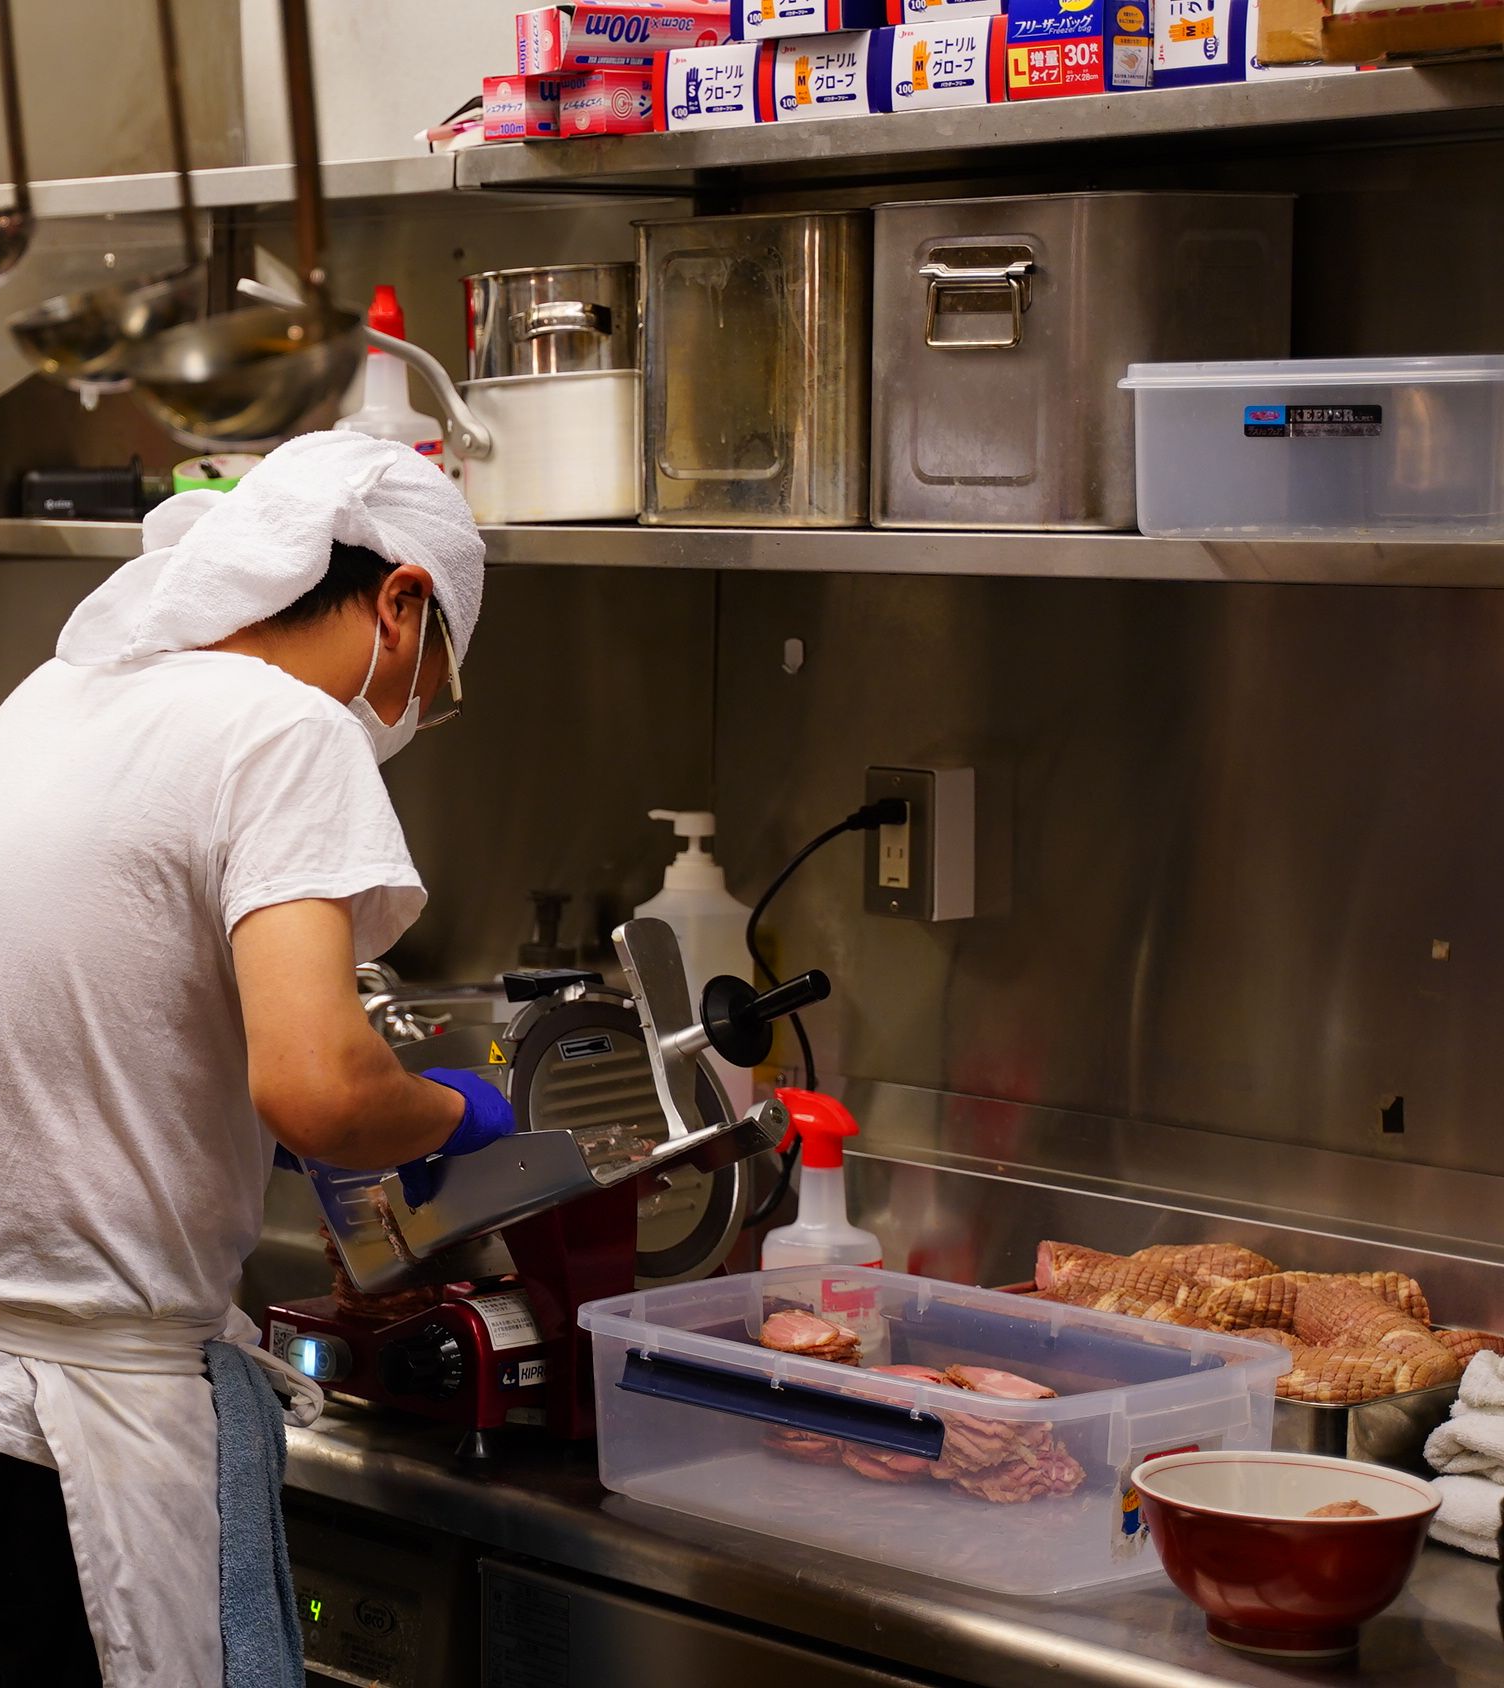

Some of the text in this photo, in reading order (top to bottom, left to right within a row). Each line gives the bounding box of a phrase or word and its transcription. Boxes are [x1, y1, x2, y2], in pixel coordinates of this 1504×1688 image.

[749, 13, 762, 23] 100
[1014, 14, 1094, 37] フリーザーバッグ
[1048, 26, 1075, 35] Freezer
[1186, 25, 1196, 36] M
[933, 37, 976, 54] ニトリル
[1206, 37, 1216, 57] 100
[815, 53, 857, 69] ニトリル
[915, 60, 924, 71] M
[1029, 50, 1059, 67] 増量
[705, 65, 744, 80] ニトリル
[932, 57, 976, 76] グローブ
[1013, 58, 1027, 77] L
[797, 75, 806, 86] M
[815, 72, 856, 91] グローブ
[1031, 68, 1059, 82] タイプ
[688, 85, 696, 97] S
[704, 84, 744, 101] グローブ
[898, 84, 913, 94] 100
[782, 98, 797, 108] 100
[674, 107, 688, 117] 100
[501, 123, 525, 134] 100m
[1290, 409, 1355, 422] KEEPER
[310, 1600, 321, 1621] 4
